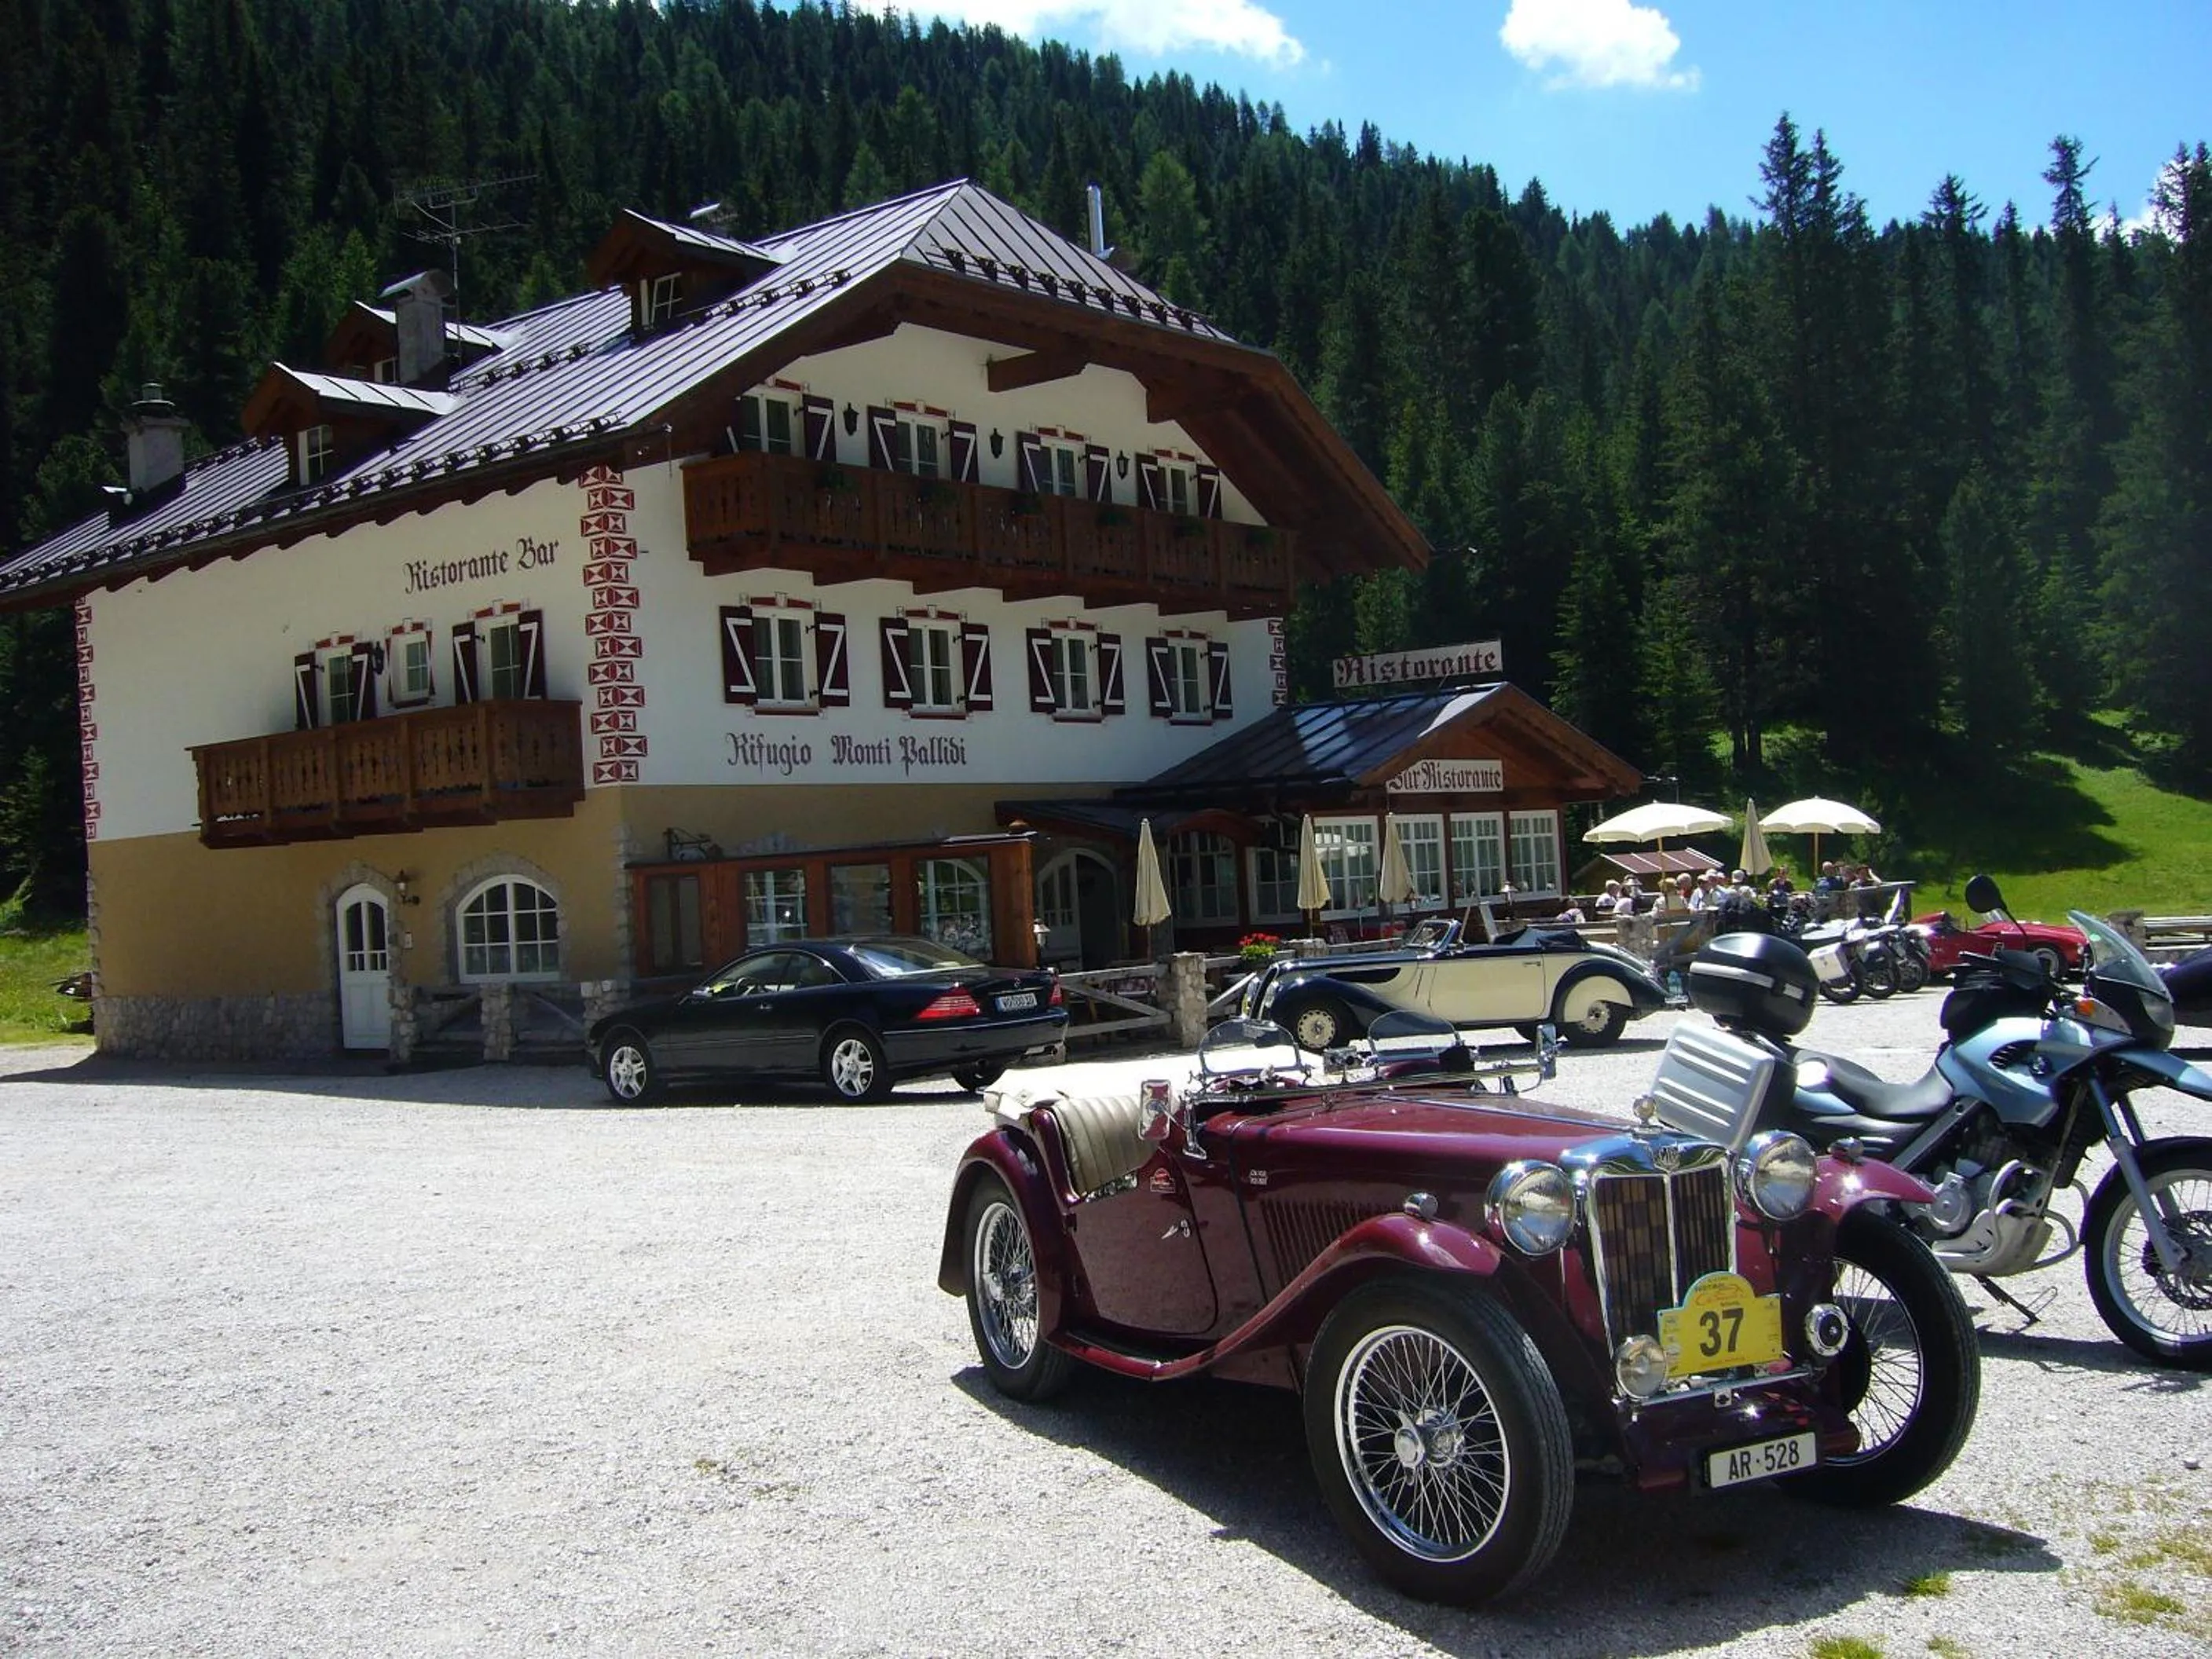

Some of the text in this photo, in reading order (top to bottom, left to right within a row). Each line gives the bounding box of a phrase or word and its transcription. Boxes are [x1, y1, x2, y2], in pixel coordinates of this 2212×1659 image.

[404, 536, 559, 595] Ristorante Bar
[1337, 647, 1497, 686] Ristorante
[726, 732, 968, 776] Rifugio Monti Pallidi
[1421, 760, 1502, 790] Ristorante
[1699, 1308, 1745, 1357] 37
